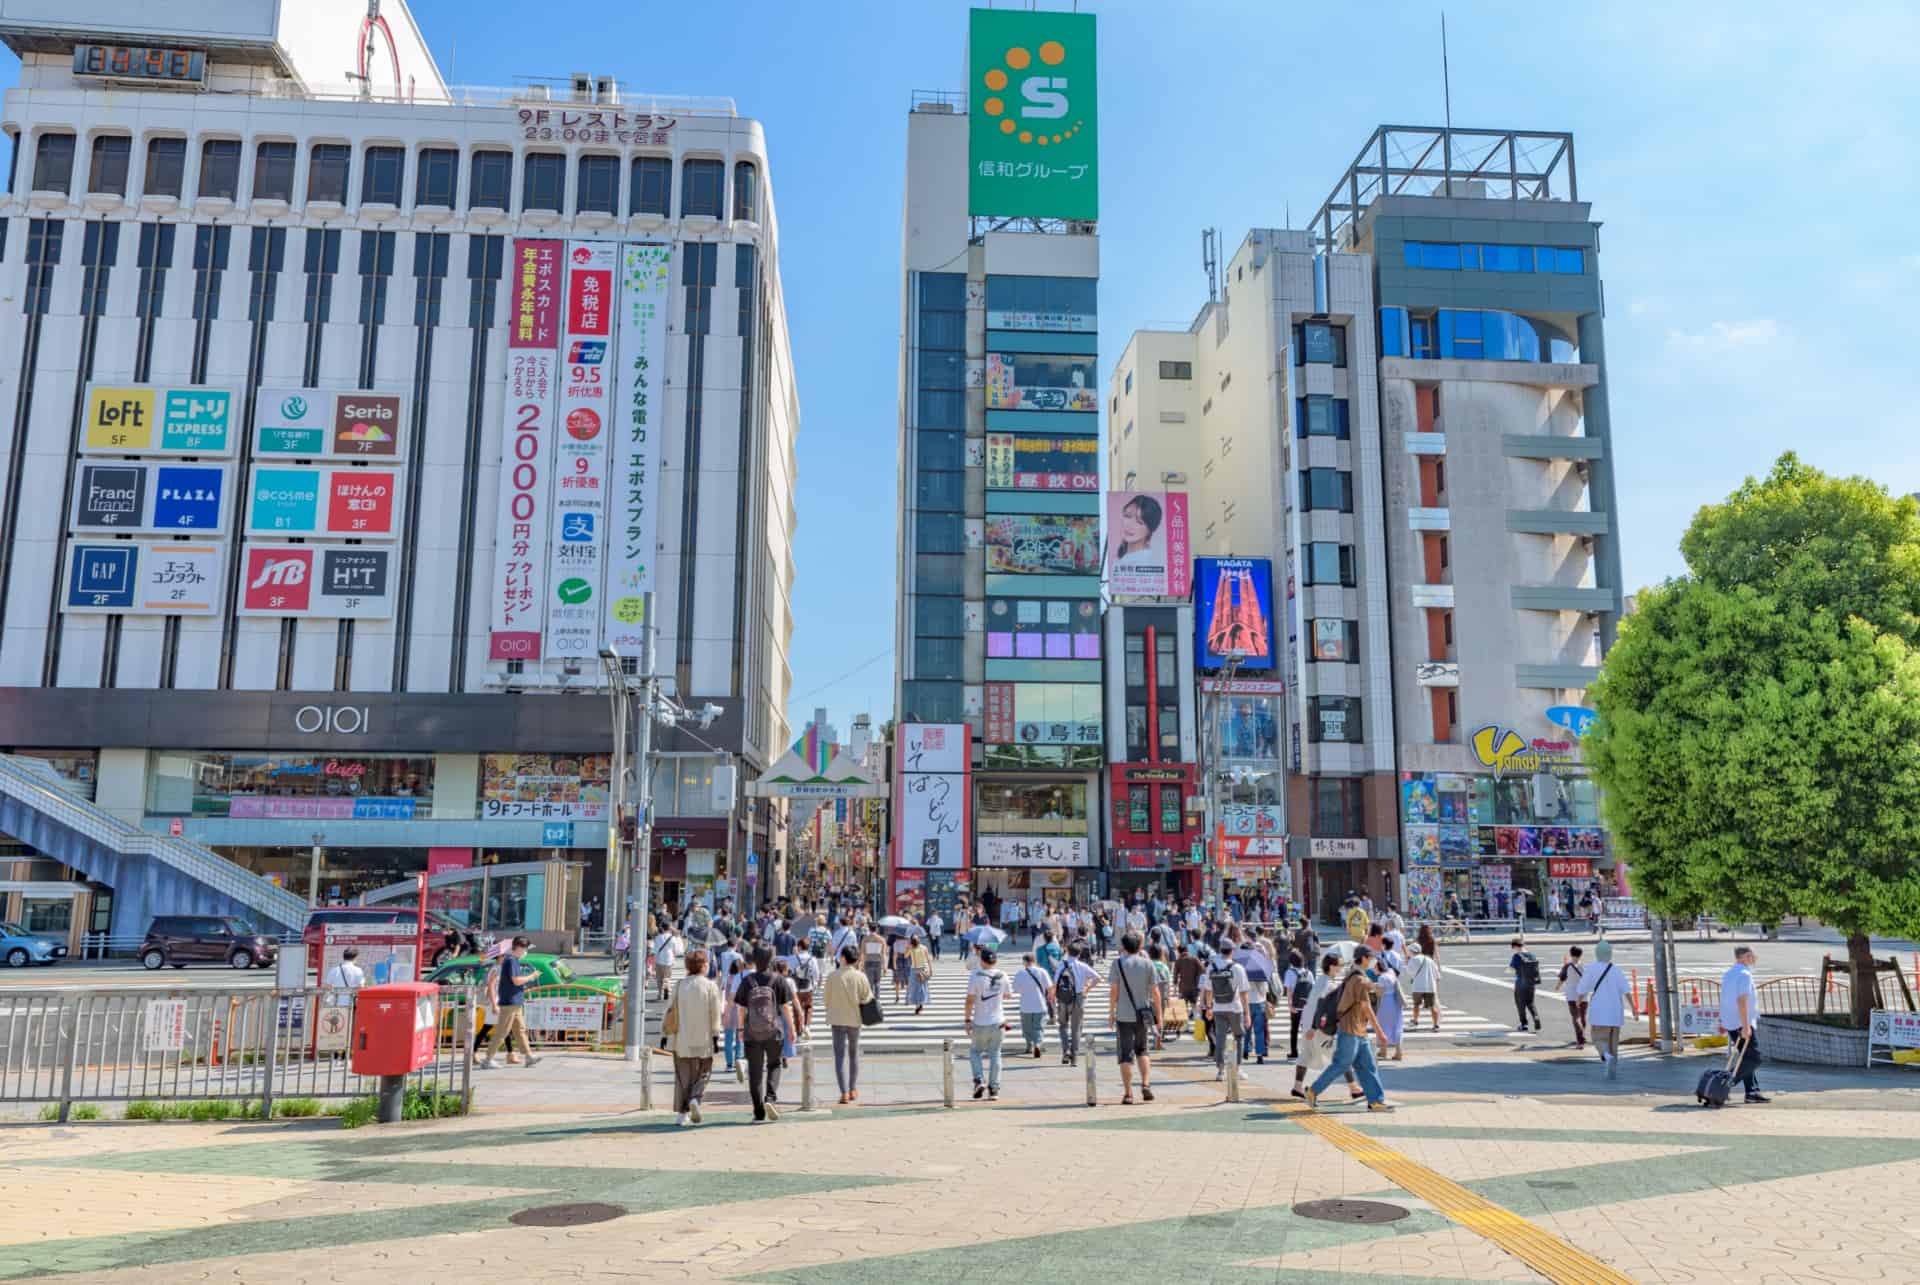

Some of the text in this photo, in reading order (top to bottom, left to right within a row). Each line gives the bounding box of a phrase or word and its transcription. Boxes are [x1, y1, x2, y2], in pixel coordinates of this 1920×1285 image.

[518, 109, 677, 130] 9F レストラン
[525, 126, 668, 145] 23:00まで営業
[978, 160, 1088, 180] 信和グループ
[518, 247, 537, 342] 年会費永年無料
[537, 249, 552, 342] エポスカード
[581, 276, 600, 329] 免税店
[571, 366, 602, 384] 9.5
[632, 356, 648, 443] みんな電力
[98, 399, 144, 427] Loft
[169, 398, 226, 419] ニトリ
[344, 404, 392, 419] Seria
[167, 423, 224, 435] EXPRESS
[111, 434, 127, 445] 5F
[283, 440, 298, 449] 3F
[357, 442, 373, 451] 7F
[575, 458, 589, 475] 9
[1072, 475, 1097, 489] OK
[90, 486, 136, 499] Franc
[162, 489, 215, 501] PLAZA
[257, 489, 314, 501] @cosme
[337, 484, 386, 497] ほけんの
[626, 454, 646, 560] エポスプラン
[102, 514, 118, 524] 4F
[177, 515, 194, 525] 4F
[275, 517, 291, 528] B1
[351, 519, 368, 529] 3F
[1171, 514, 1185, 594] 品川美容外科
[91, 562, 117, 580] GAP
[165, 561, 194, 573] エース
[1216, 559, 1253, 567] NAGATA
[152, 572, 206, 584] コンタクト
[251, 558, 306, 590] JTB
[504, 561, 517, 626] プレゼント
[519, 561, 533, 612] クーポン
[93, 594, 110, 604] 2F
[170, 590, 187, 600] 2F
[269, 596, 286, 607] 3F
[345, 598, 361, 608] 3F
[295, 706, 369, 733] OIOI
[488, 799, 573, 817] 9Fフードホール
[929, 775, 959, 835] うどん
[1011, 841, 1063, 861] ねぎし
[1071, 841, 1081, 861] 2F
